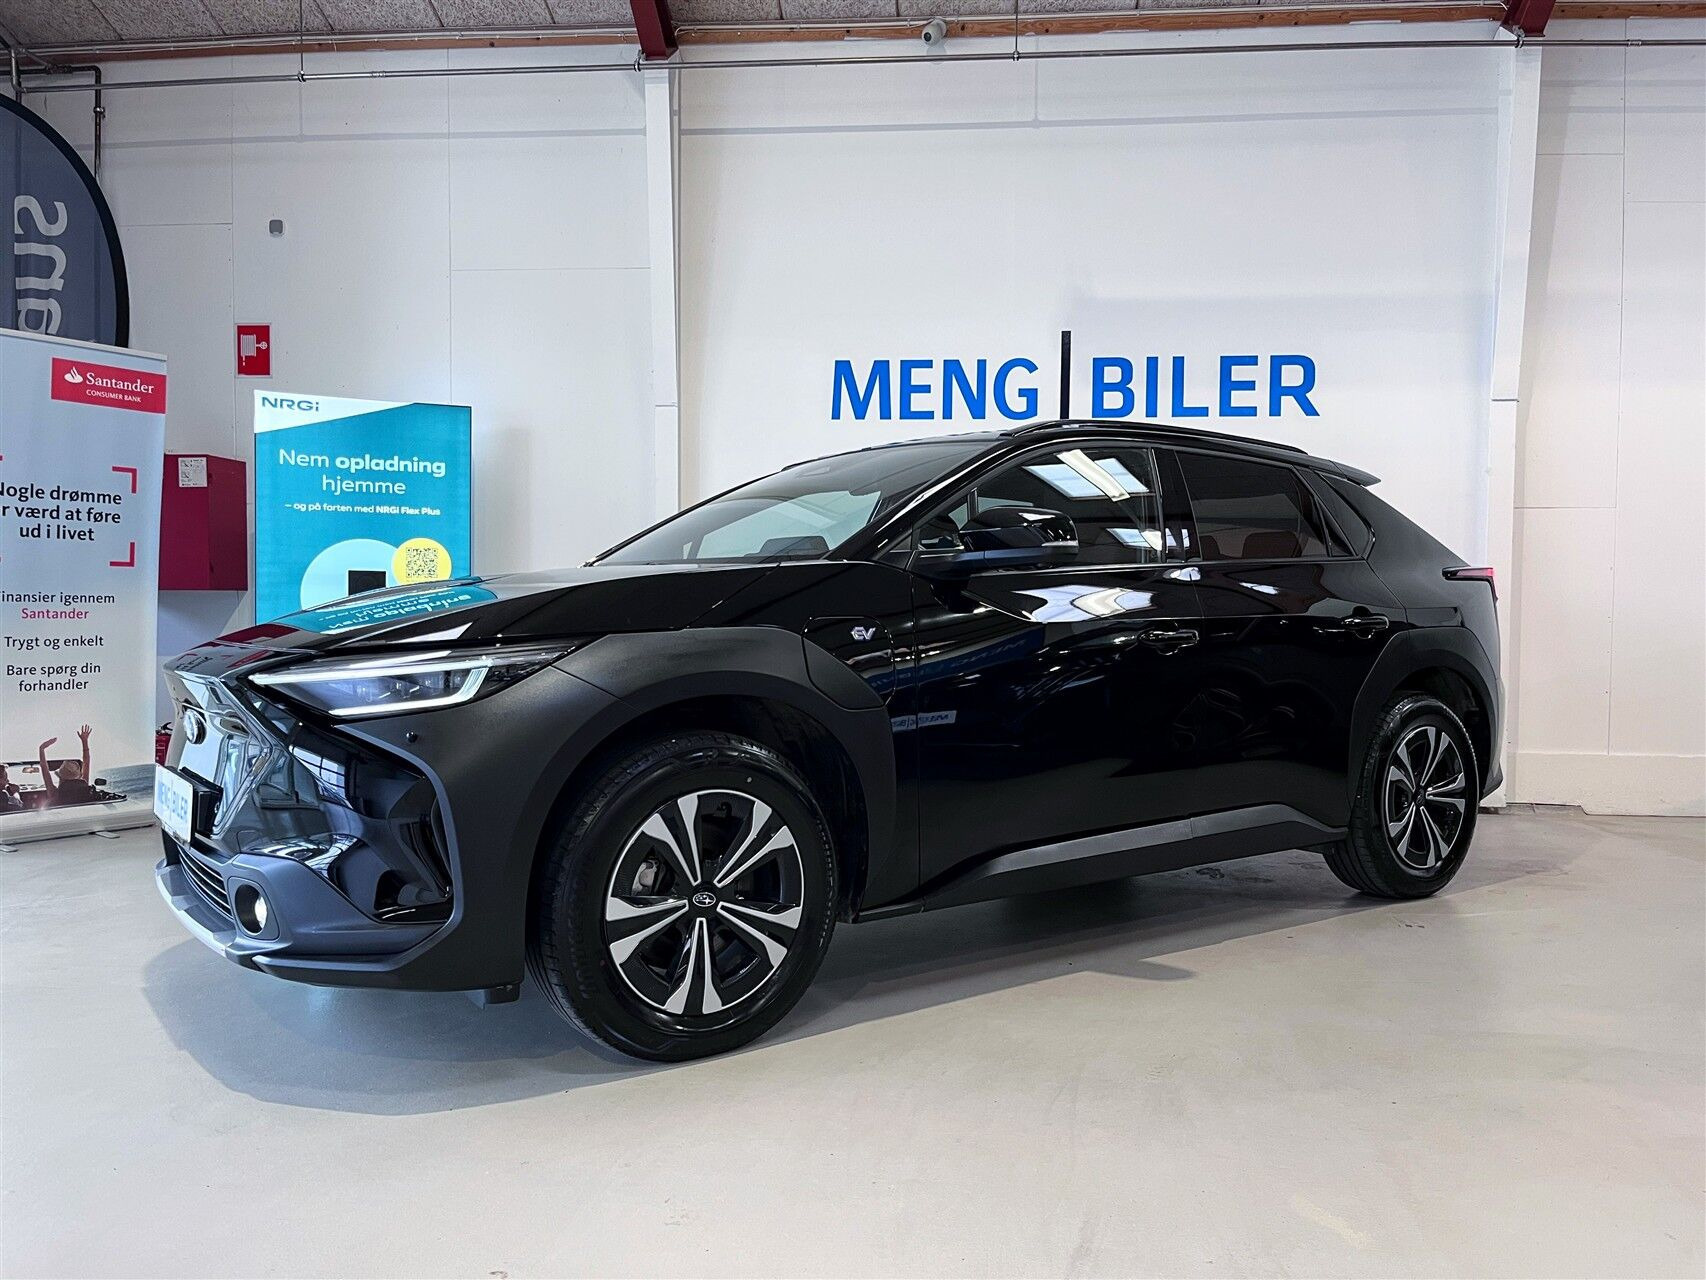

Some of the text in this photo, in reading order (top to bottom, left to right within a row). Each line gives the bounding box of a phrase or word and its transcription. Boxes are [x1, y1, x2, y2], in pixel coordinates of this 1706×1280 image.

[86, 372, 154, 394] Santander
[830, 354, 1321, 421] MENG BILER
[86, 389, 142, 403] CONSUMER BANK
[261, 396, 320, 412] NRGi
[279, 448, 446, 478] Nem opladning
[322, 474, 406, 496] hjemme
[50, 485, 122, 505] drømme
[14, 505, 60, 520] værd
[65, 509, 82, 522] at
[86, 507, 121, 524] føre
[293, 502, 306, 512] og
[308, 502, 321, 512] på
[322, 503, 352, 513] farten
[354, 504, 375, 513] med
[401, 506, 420, 515] Flex
[421, 507, 441, 516] Plus
[19, 524, 95, 541] ud i livet
[0, 591, 115, 606] inansier igennem
[21, 608, 89, 619] Santander
[851, 626, 876, 641] EV
[4, 635, 104, 651] Trygt og enkelt
[6, 662, 101, 678] Bare spørg din
[19, 679, 89, 692] forhandler
